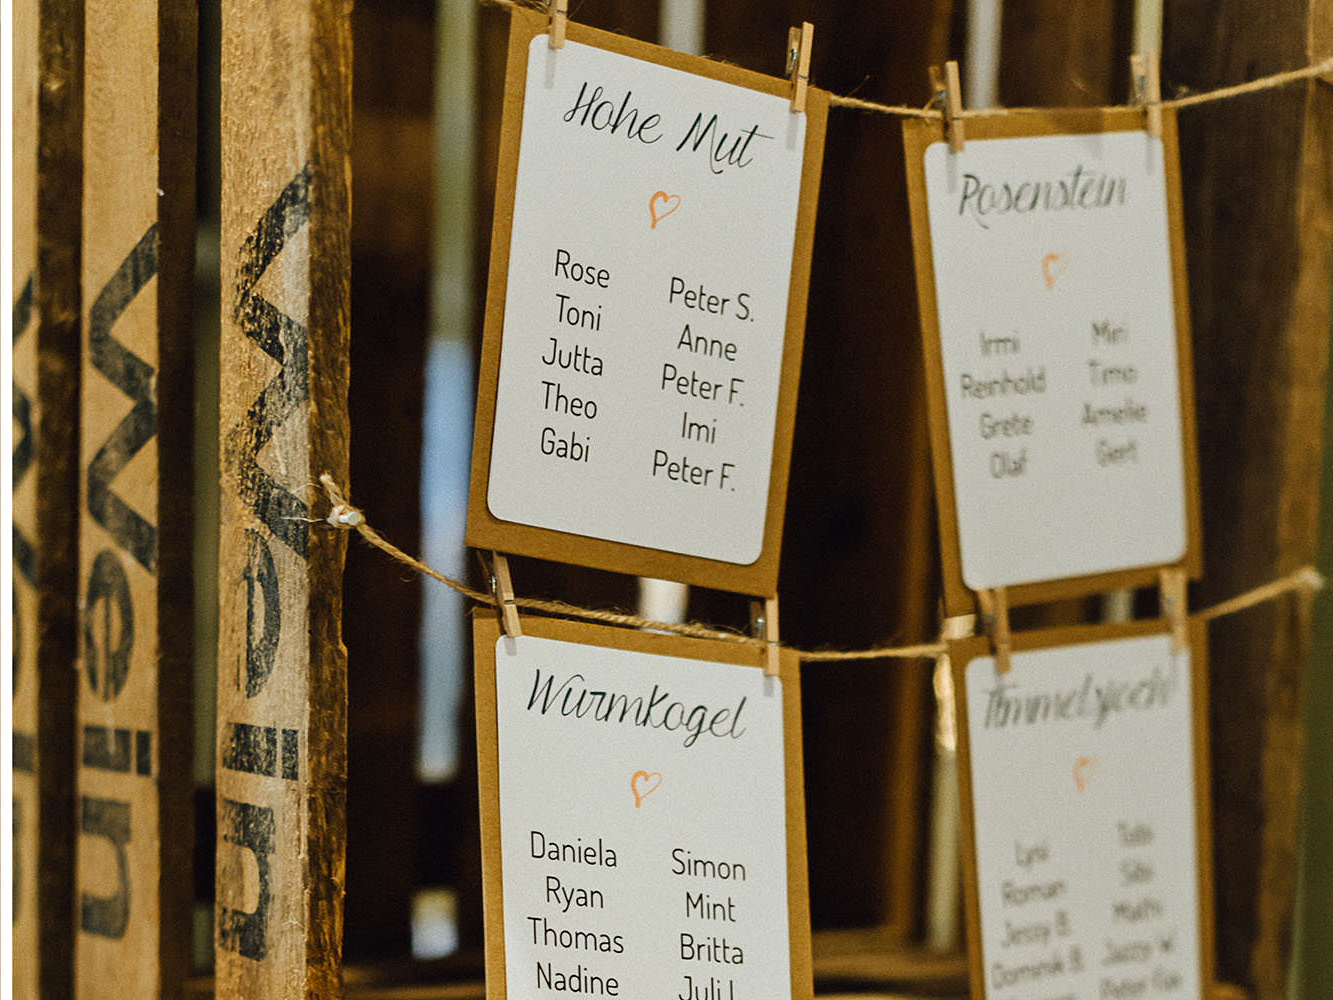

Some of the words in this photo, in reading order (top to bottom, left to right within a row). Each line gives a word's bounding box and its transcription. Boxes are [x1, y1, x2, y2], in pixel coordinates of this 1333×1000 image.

[564, 82, 662, 143] Hohe
[676, 112, 772, 174] Mut
[555, 249, 609, 288] Rose
[556, 294, 601, 331] Toni
[670, 277, 730, 315] Peter
[736, 293, 753, 322] S.
[542, 338, 603, 376] Jutta
[677, 324, 737, 361] Anne
[542, 381, 597, 419] Theo
[662, 363, 723, 400] Peter
[729, 378, 744, 406] F.
[541, 427, 590, 462] Gabi
[682, 412, 716, 444] Imi
[653, 450, 713, 485] Peter
[720, 463, 735, 491] F.
[79, 224, 159, 940] Wein
[527, 669, 746, 748] Wurmkogel
[531, 831, 617, 867] Daniela
[672, 848, 745, 880] Simon
[546, 876, 603, 913] Ryan
[686, 892, 736, 922] Mint
[527, 917, 624, 953] Thomas
[681, 933, 743, 964] Britta
[537, 962, 618, 996] Nadine
